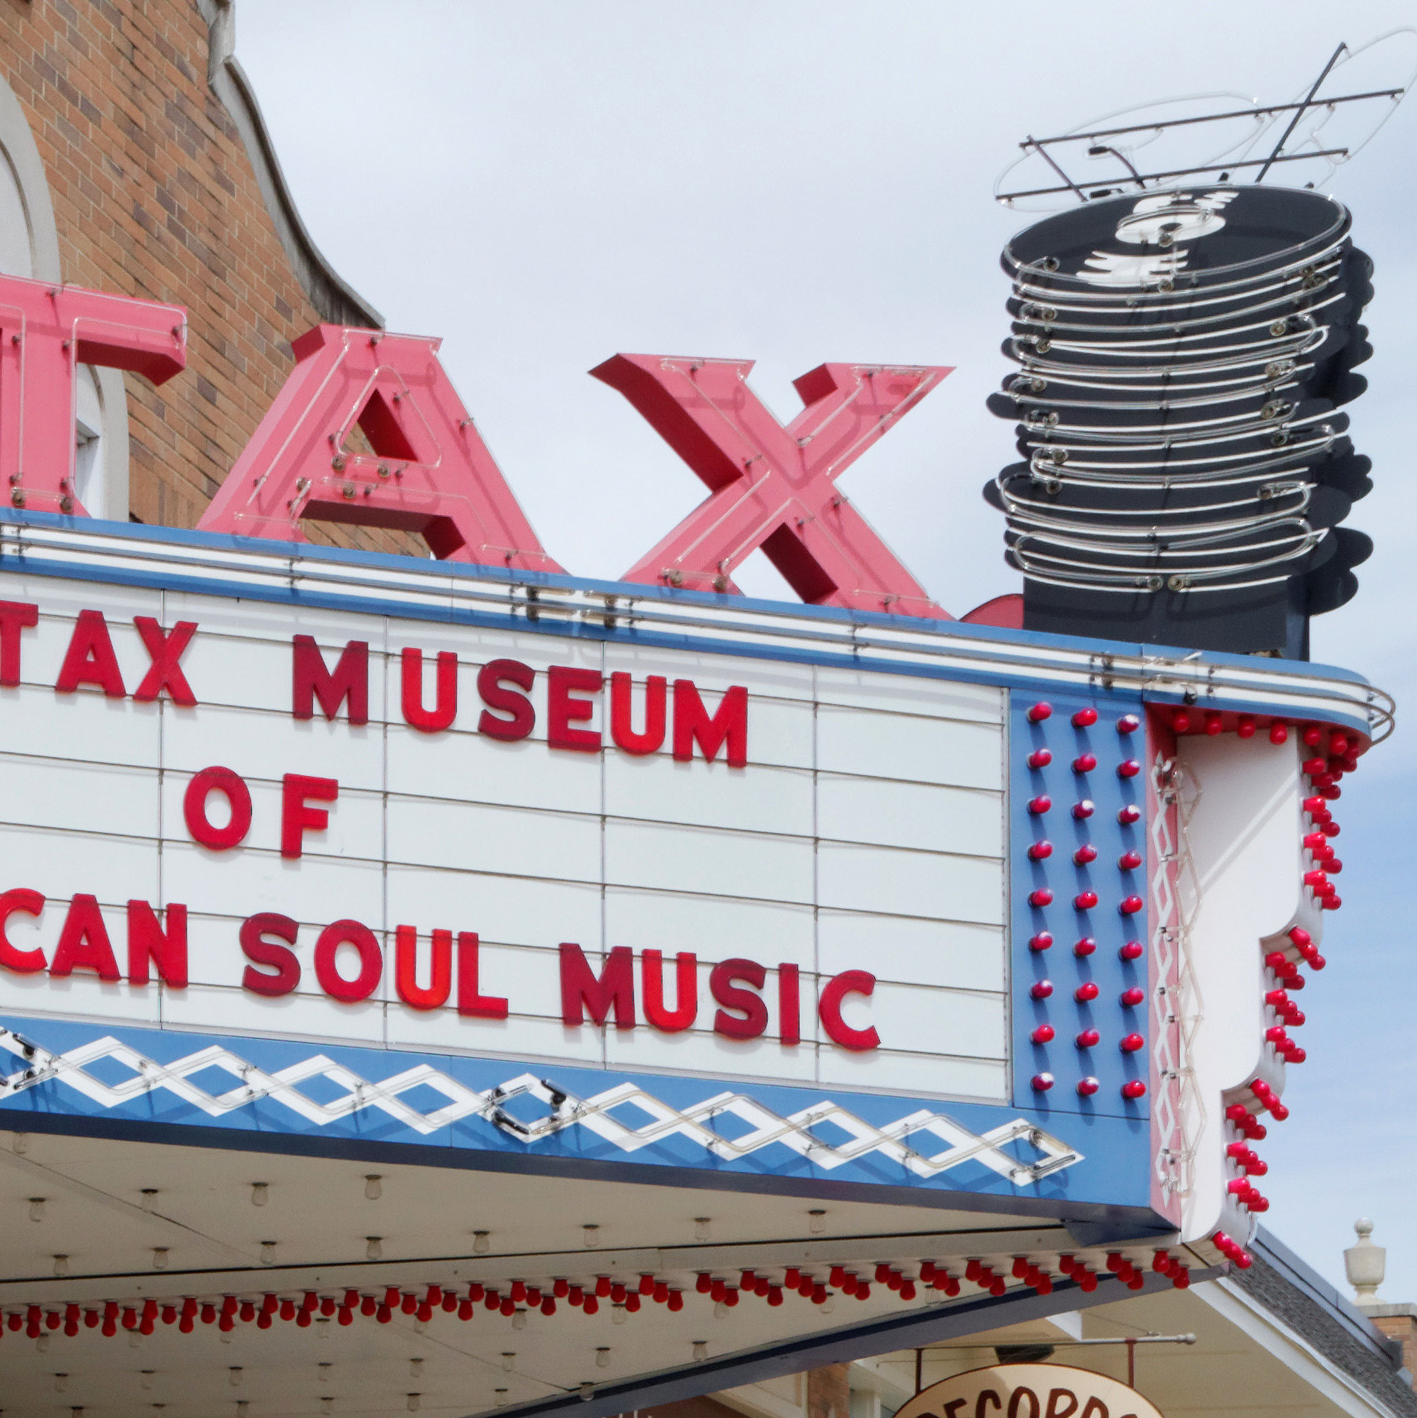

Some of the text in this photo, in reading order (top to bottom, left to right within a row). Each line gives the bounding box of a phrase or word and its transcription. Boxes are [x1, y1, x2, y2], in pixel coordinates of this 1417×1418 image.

[292, 633, 749, 768] MUSEUM
[184, 765, 339, 860] OF
[239, 911, 509, 1021] SOUL
[559, 941, 881, 1051] MUSIC
